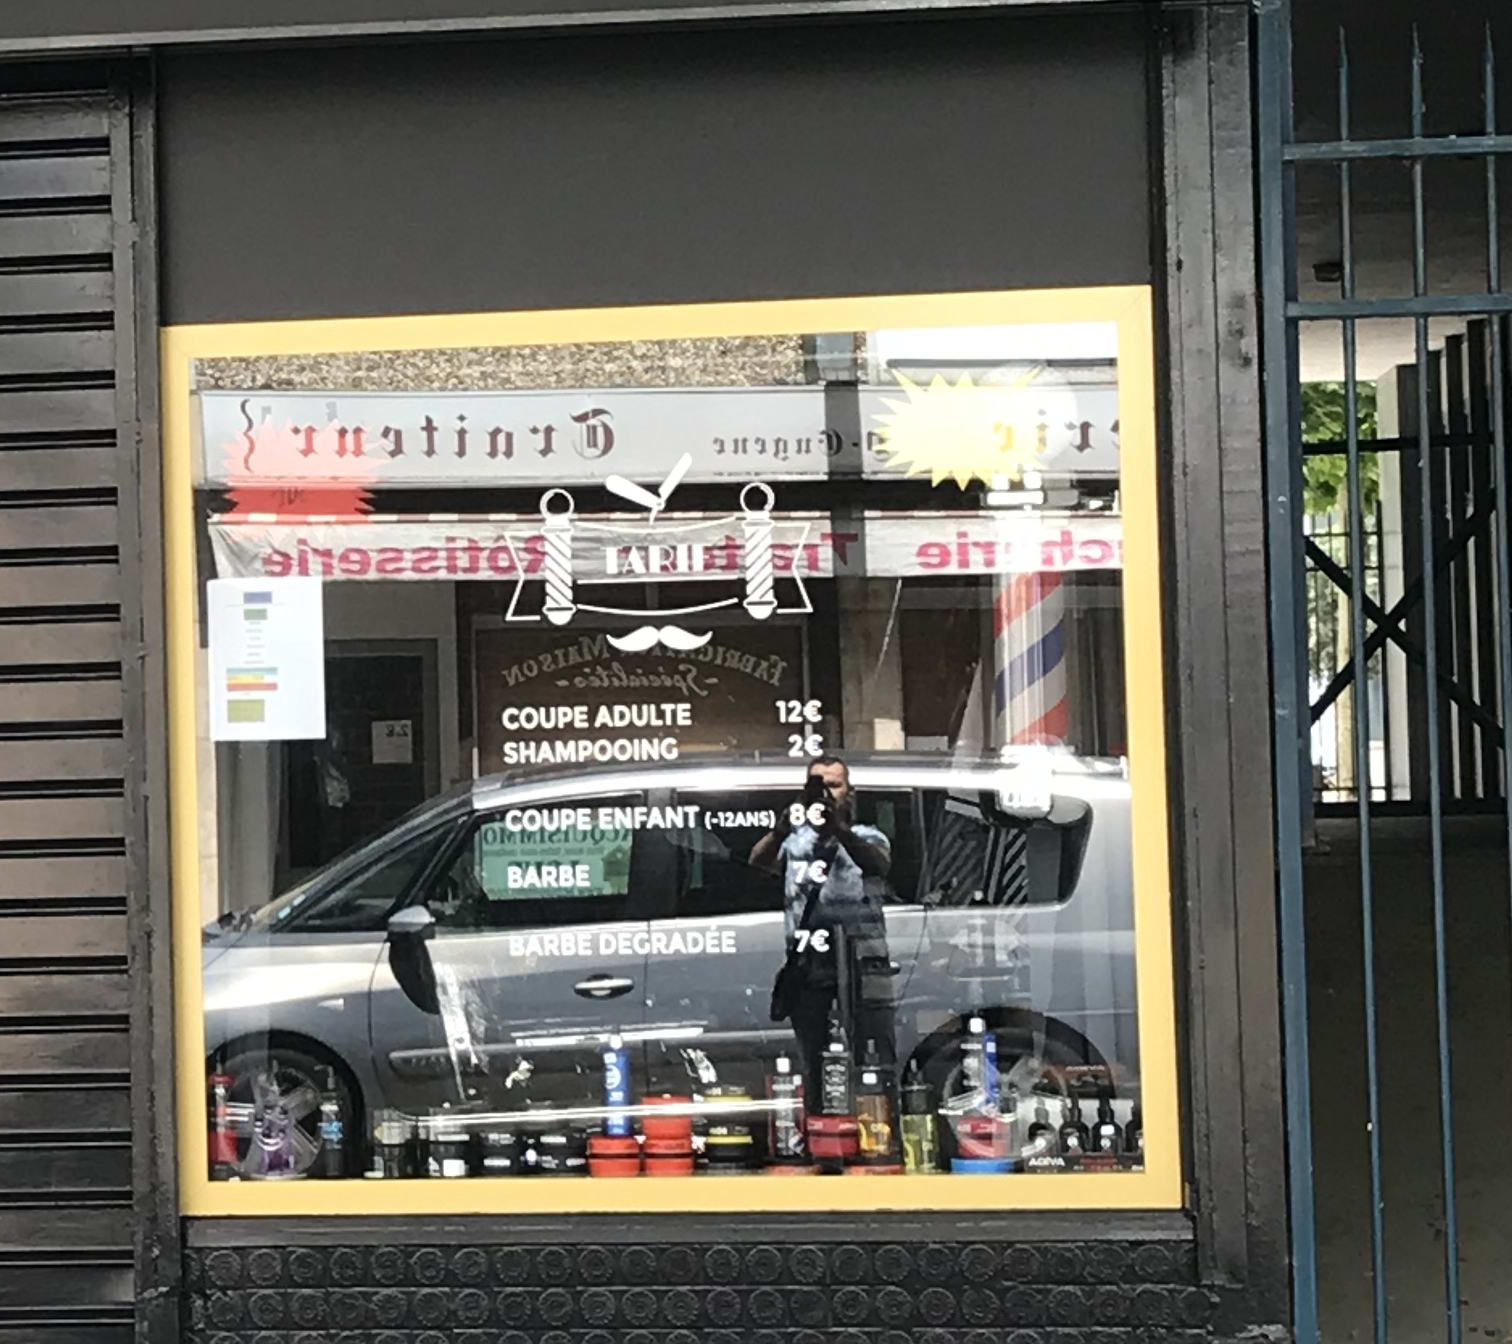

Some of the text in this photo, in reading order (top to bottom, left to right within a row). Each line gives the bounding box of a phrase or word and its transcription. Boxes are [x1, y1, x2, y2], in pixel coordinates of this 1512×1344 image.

[502, 699, 823, 730] COUPE ADULTE 12€
[503, 734, 824, 764] SHAMPOOING 2€
[505, 803, 827, 832] COUPE ENFANT (-12ANS) 8€
[507, 860, 829, 889] BARBE 7€
[509, 925, 831, 957] BARBE DEGRADÉE 7€
